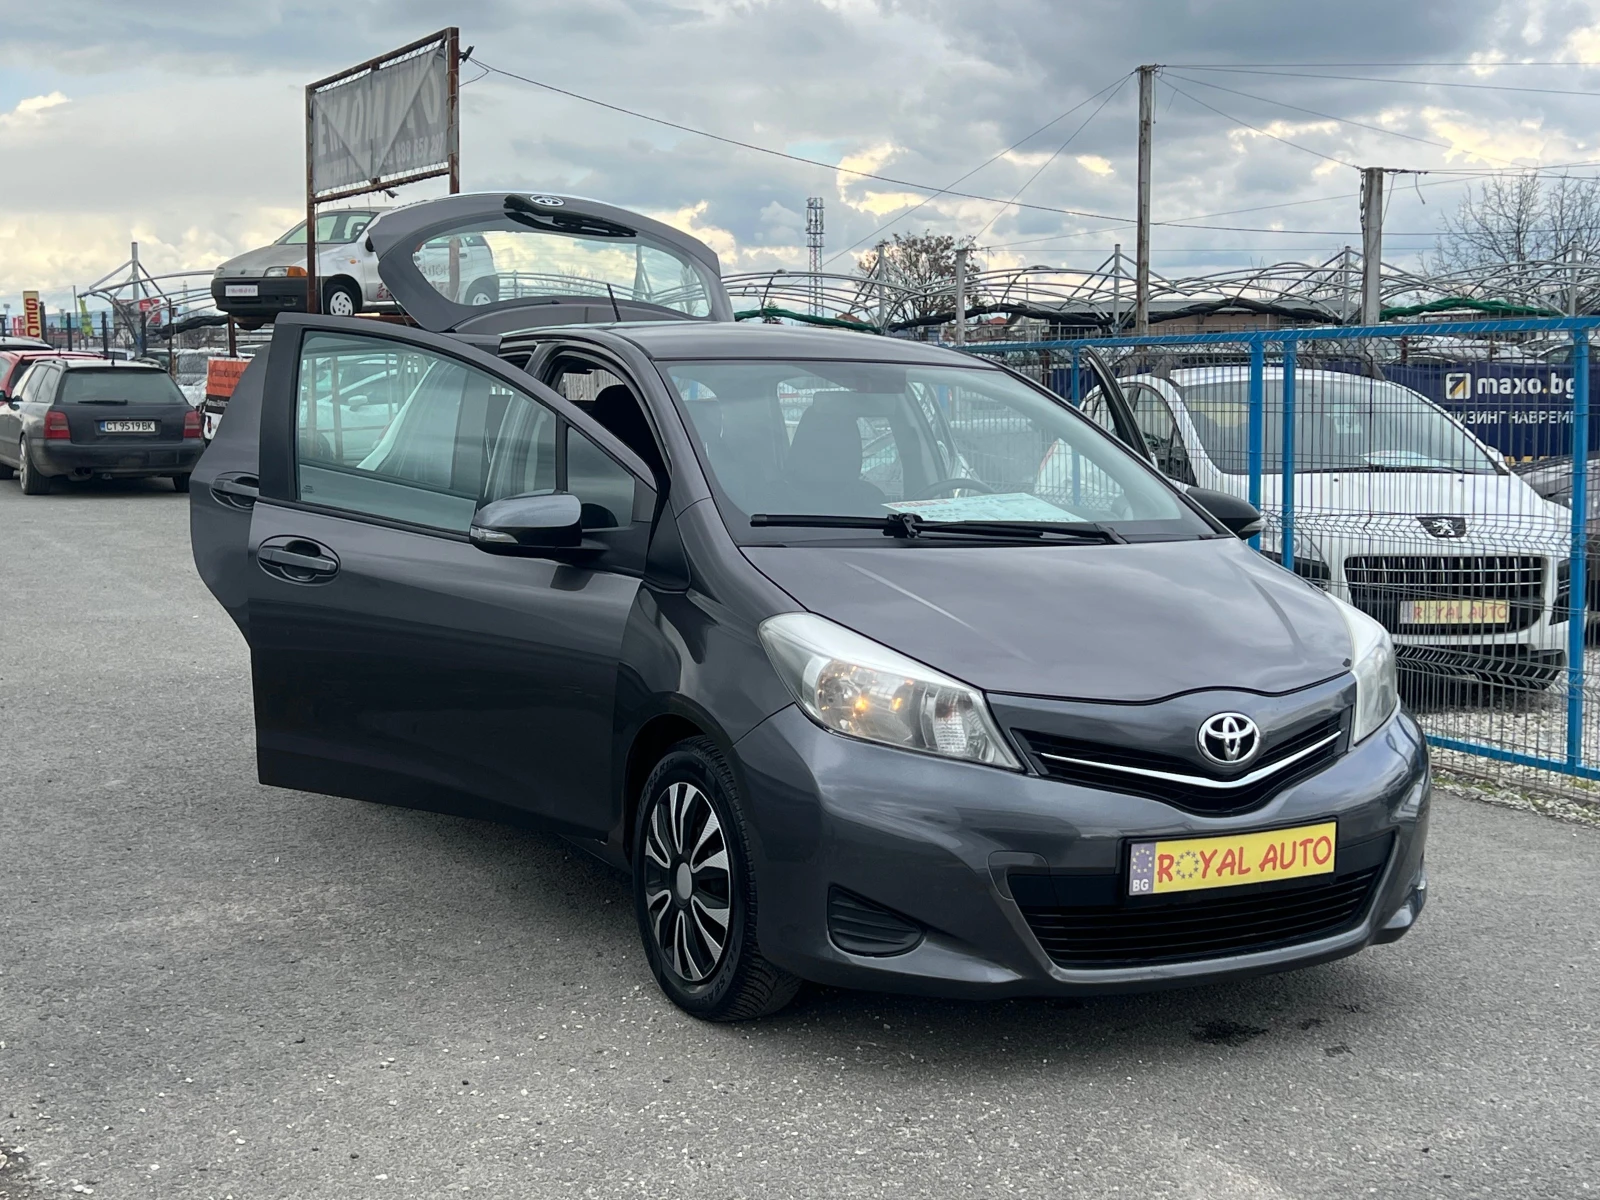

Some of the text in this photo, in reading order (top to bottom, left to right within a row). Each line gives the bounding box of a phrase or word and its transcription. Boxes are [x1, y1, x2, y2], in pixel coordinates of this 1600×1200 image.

[1157, 835, 1333, 883] ROYAL AUTO
[1132, 879, 1149, 892] BG
